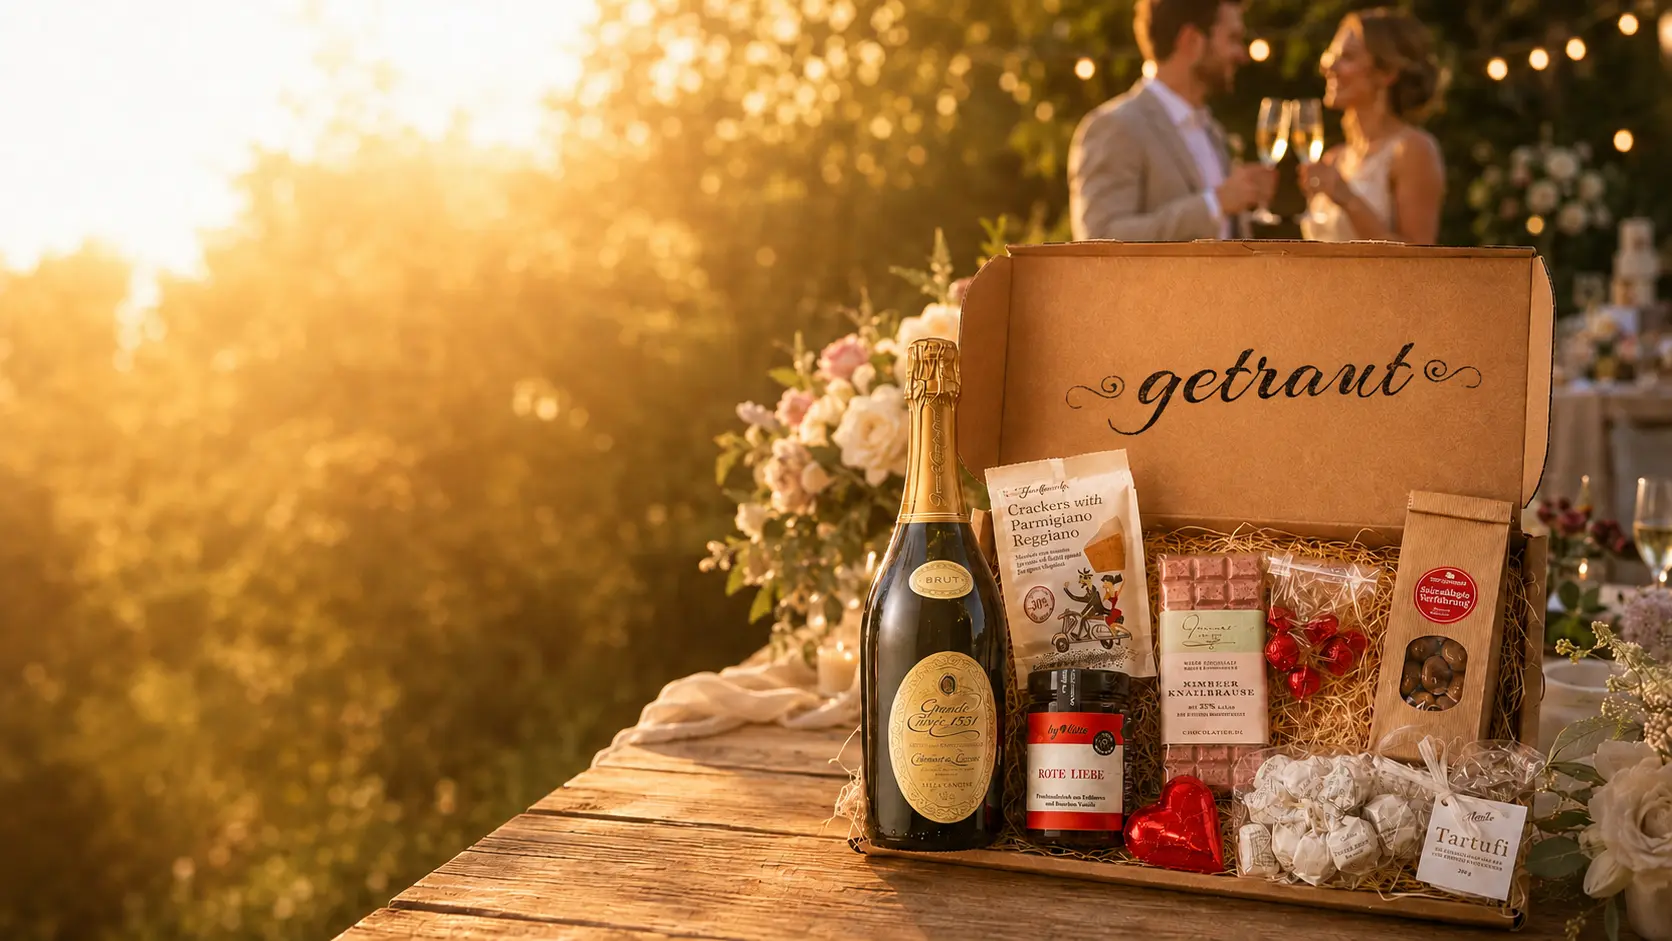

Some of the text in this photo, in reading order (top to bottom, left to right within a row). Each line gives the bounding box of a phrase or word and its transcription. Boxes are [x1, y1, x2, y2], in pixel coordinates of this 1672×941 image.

[1108, 342, 1415, 435] getraut
[1008, 494, 1103, 516] Crackers with
[1011, 512, 1092, 531] Parmigiano
[1013, 529, 1080, 548] Reggiano
[925, 576, 960, 584] BRUT
[1038, 769, 1105, 780] ROTE LIEBE
[1435, 826, 1509, 857] Tartufi
